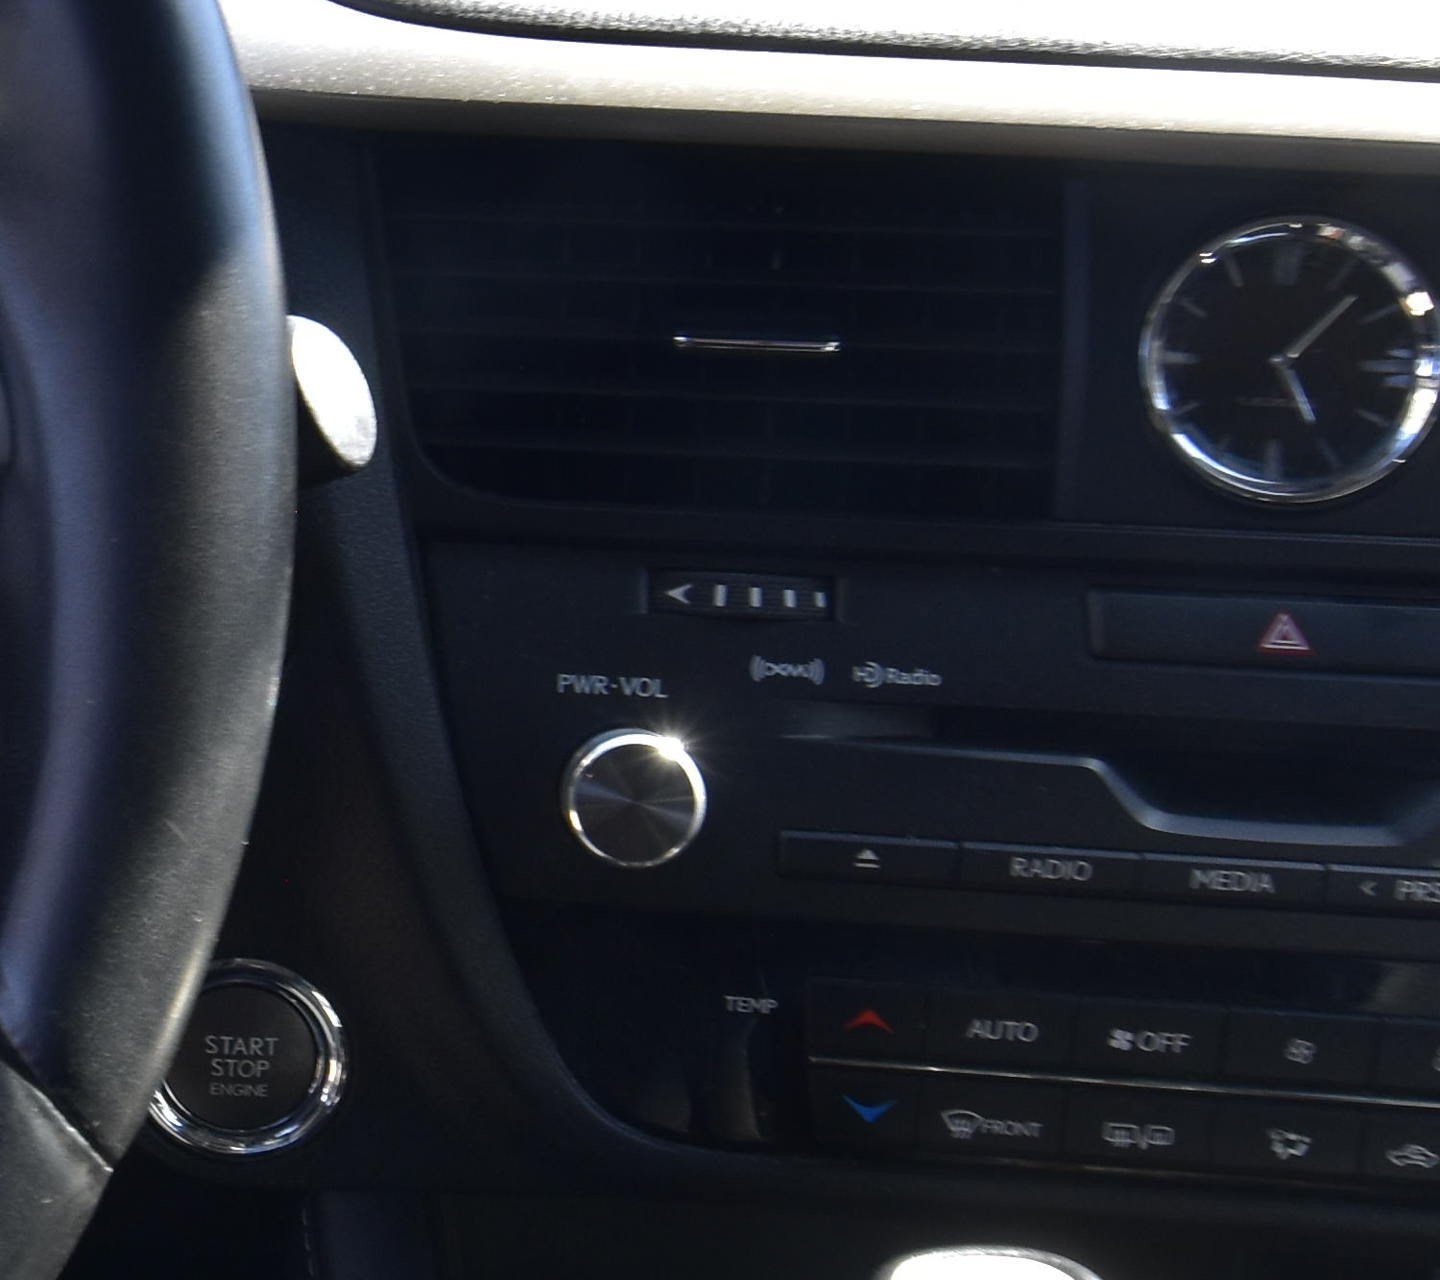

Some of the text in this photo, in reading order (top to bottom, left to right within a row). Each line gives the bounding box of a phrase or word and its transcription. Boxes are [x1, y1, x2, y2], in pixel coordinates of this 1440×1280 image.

[1008, 855, 1094, 883] RADIO
[1188, 868, 1276, 895] MEDIA
[724, 993, 779, 1017] TEMP
[965, 1017, 1040, 1044] AUTO
[1135, 1030, 1194, 1055] OFF
[204, 1034, 280, 1057] START
[210, 1058, 271, 1078] STOP
[209, 1083, 270, 1098] ENGINE
[982, 1118, 1045, 1139] FRONT
